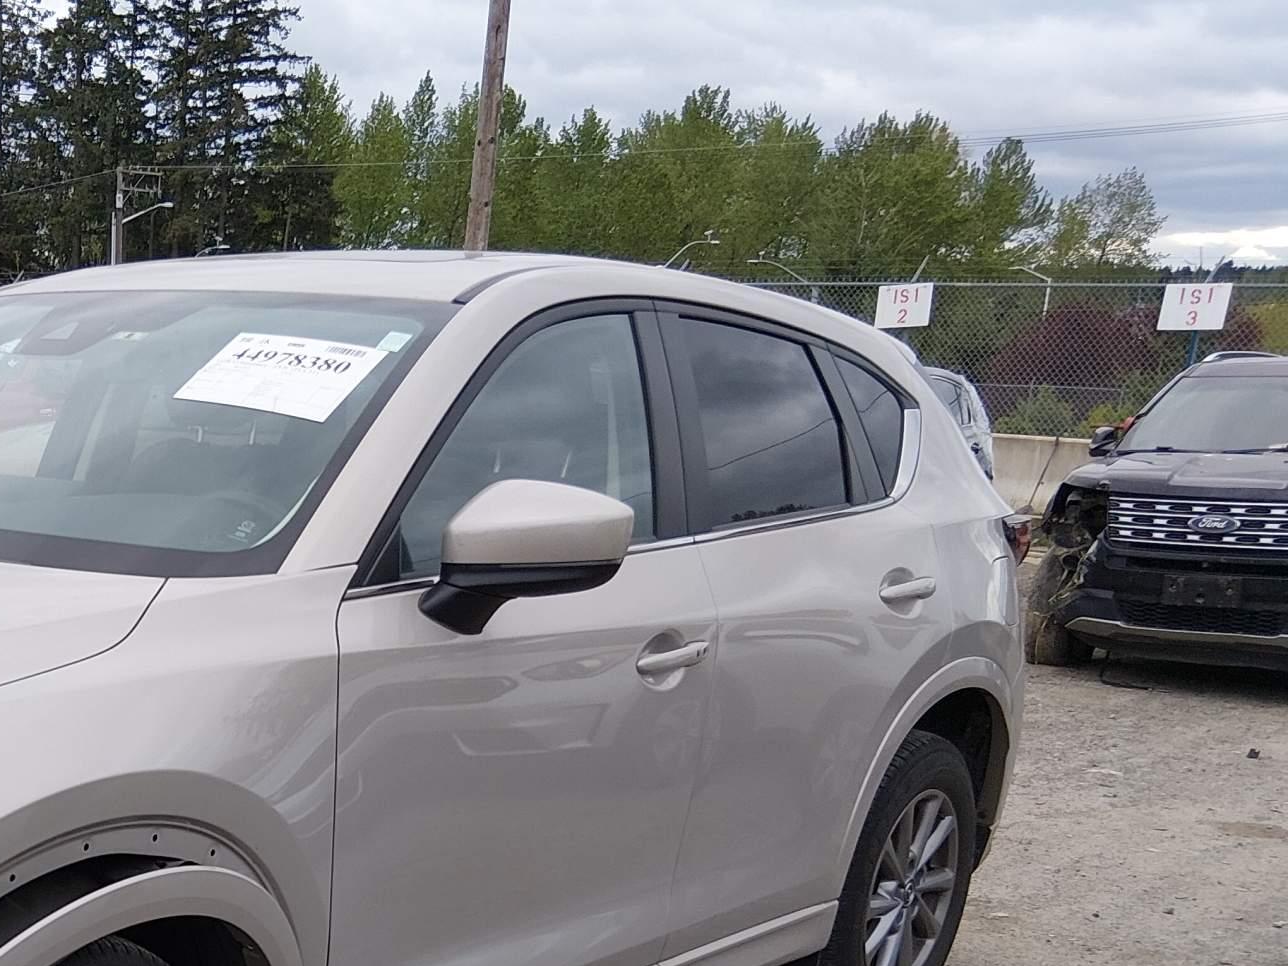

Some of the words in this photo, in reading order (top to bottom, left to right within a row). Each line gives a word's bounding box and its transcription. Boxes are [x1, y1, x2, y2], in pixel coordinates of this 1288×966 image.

[896, 308, 908, 324] 2
[1185, 310, 1198, 326] 3
[232, 348, 351, 374] 44978380
[1198, 516, 1228, 528] Ford
